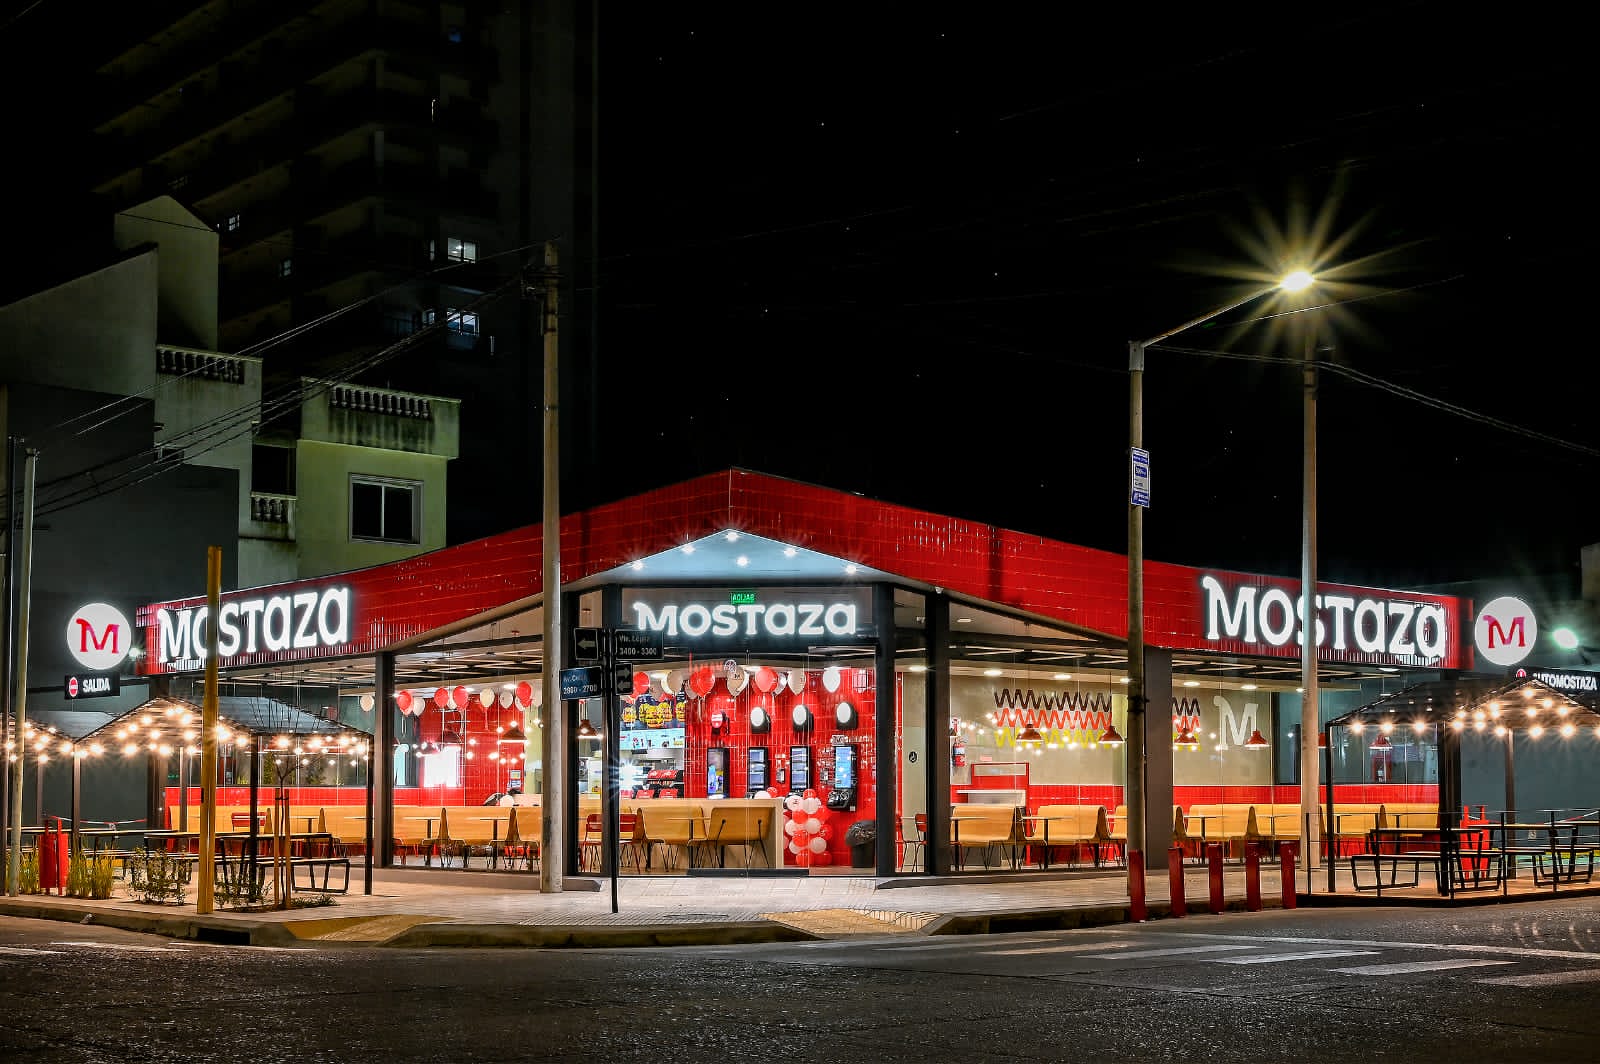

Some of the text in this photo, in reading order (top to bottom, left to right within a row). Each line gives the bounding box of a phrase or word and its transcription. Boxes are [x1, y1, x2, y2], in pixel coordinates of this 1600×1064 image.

[75, 617, 120, 654] M
[1482, 614, 1526, 649] M
[82, 677, 111, 693] SALIDA
